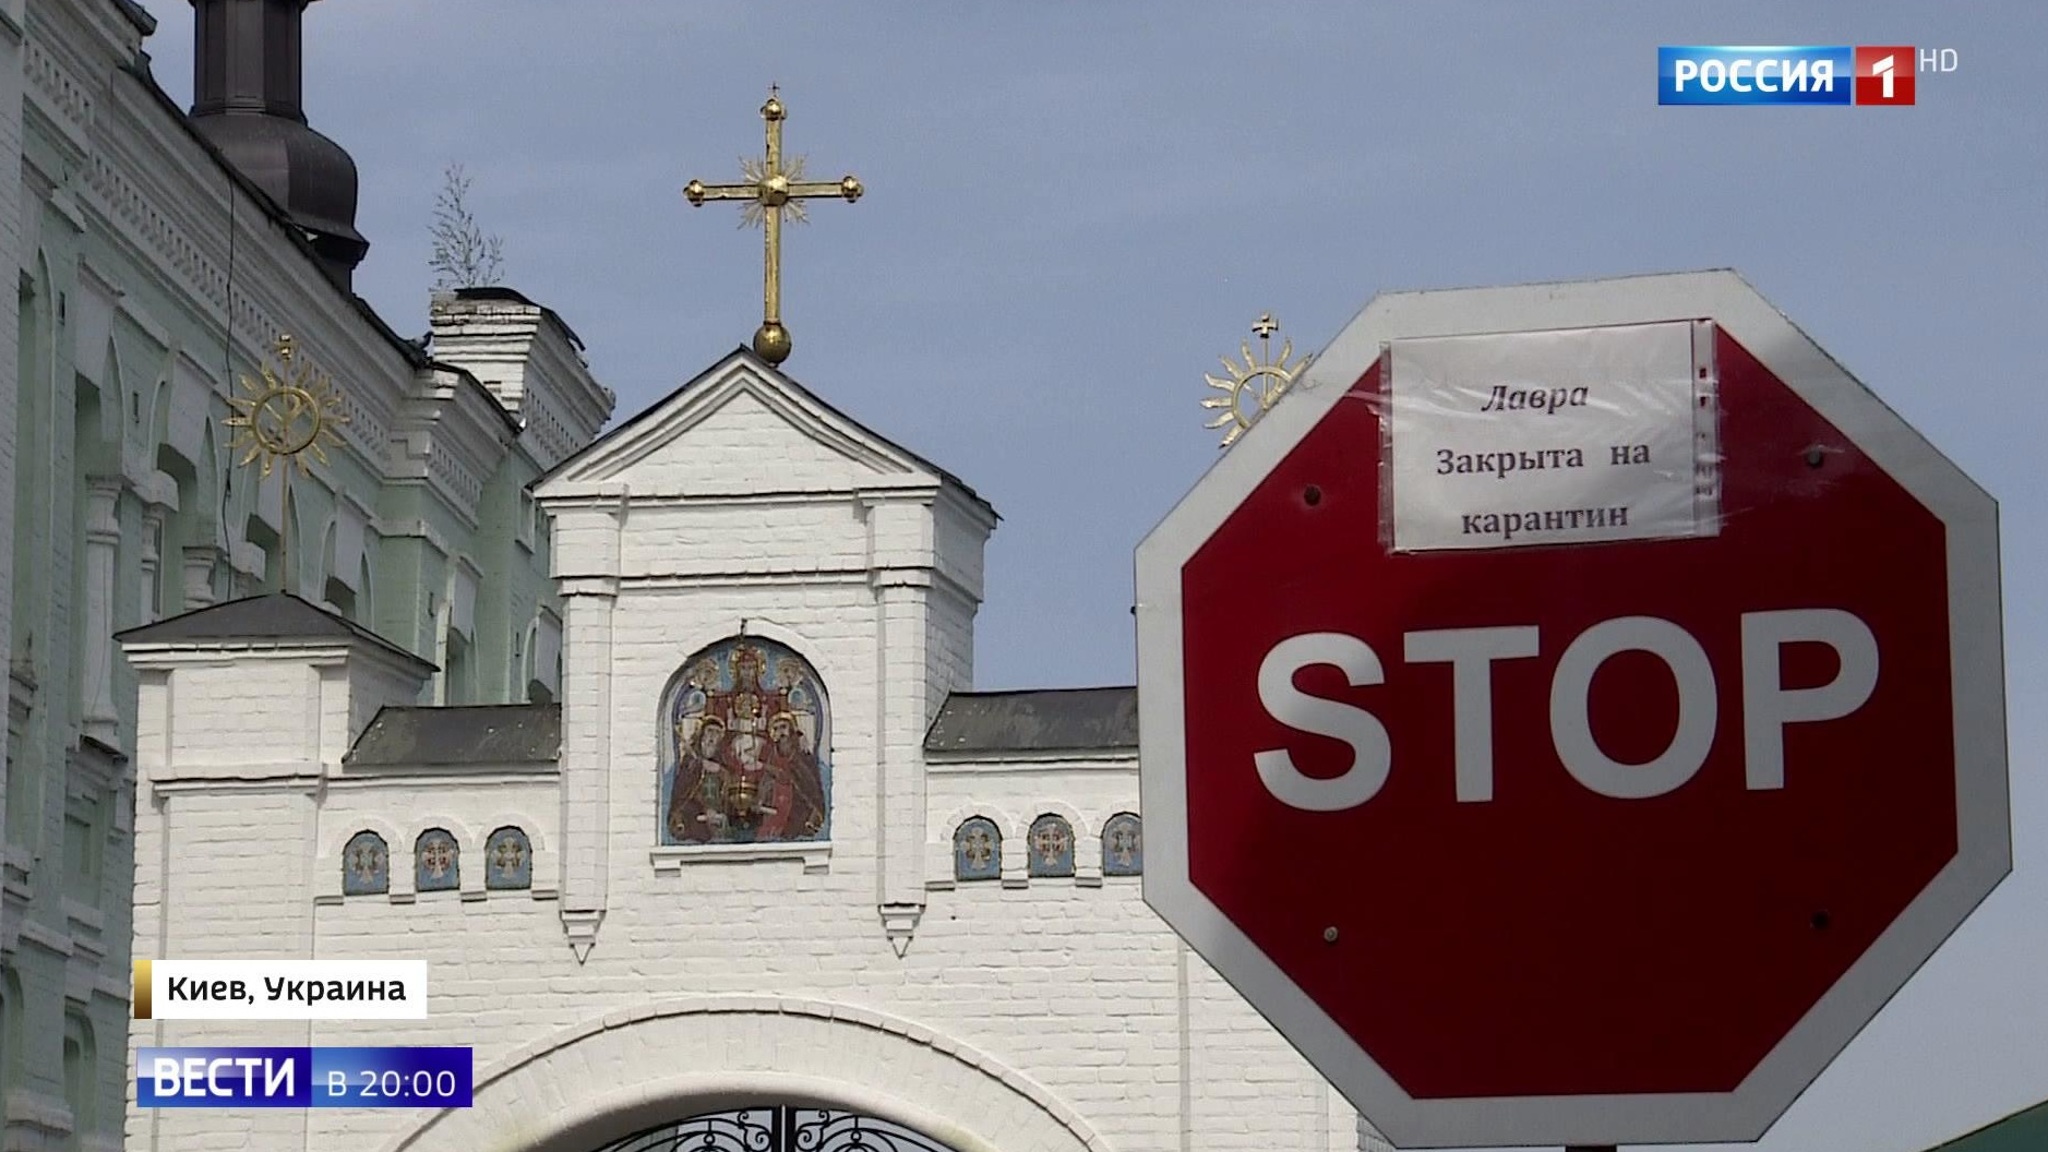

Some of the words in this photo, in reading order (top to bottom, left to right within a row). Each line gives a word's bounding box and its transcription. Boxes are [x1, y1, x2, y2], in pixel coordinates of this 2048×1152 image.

[1481, 384, 1589, 413] Лавра
[1437, 447, 1584, 478] Закрыта
[1610, 444, 1651, 466] на
[1462, 506, 1629, 539] карантин
[1253, 608, 1880, 811] STOP
